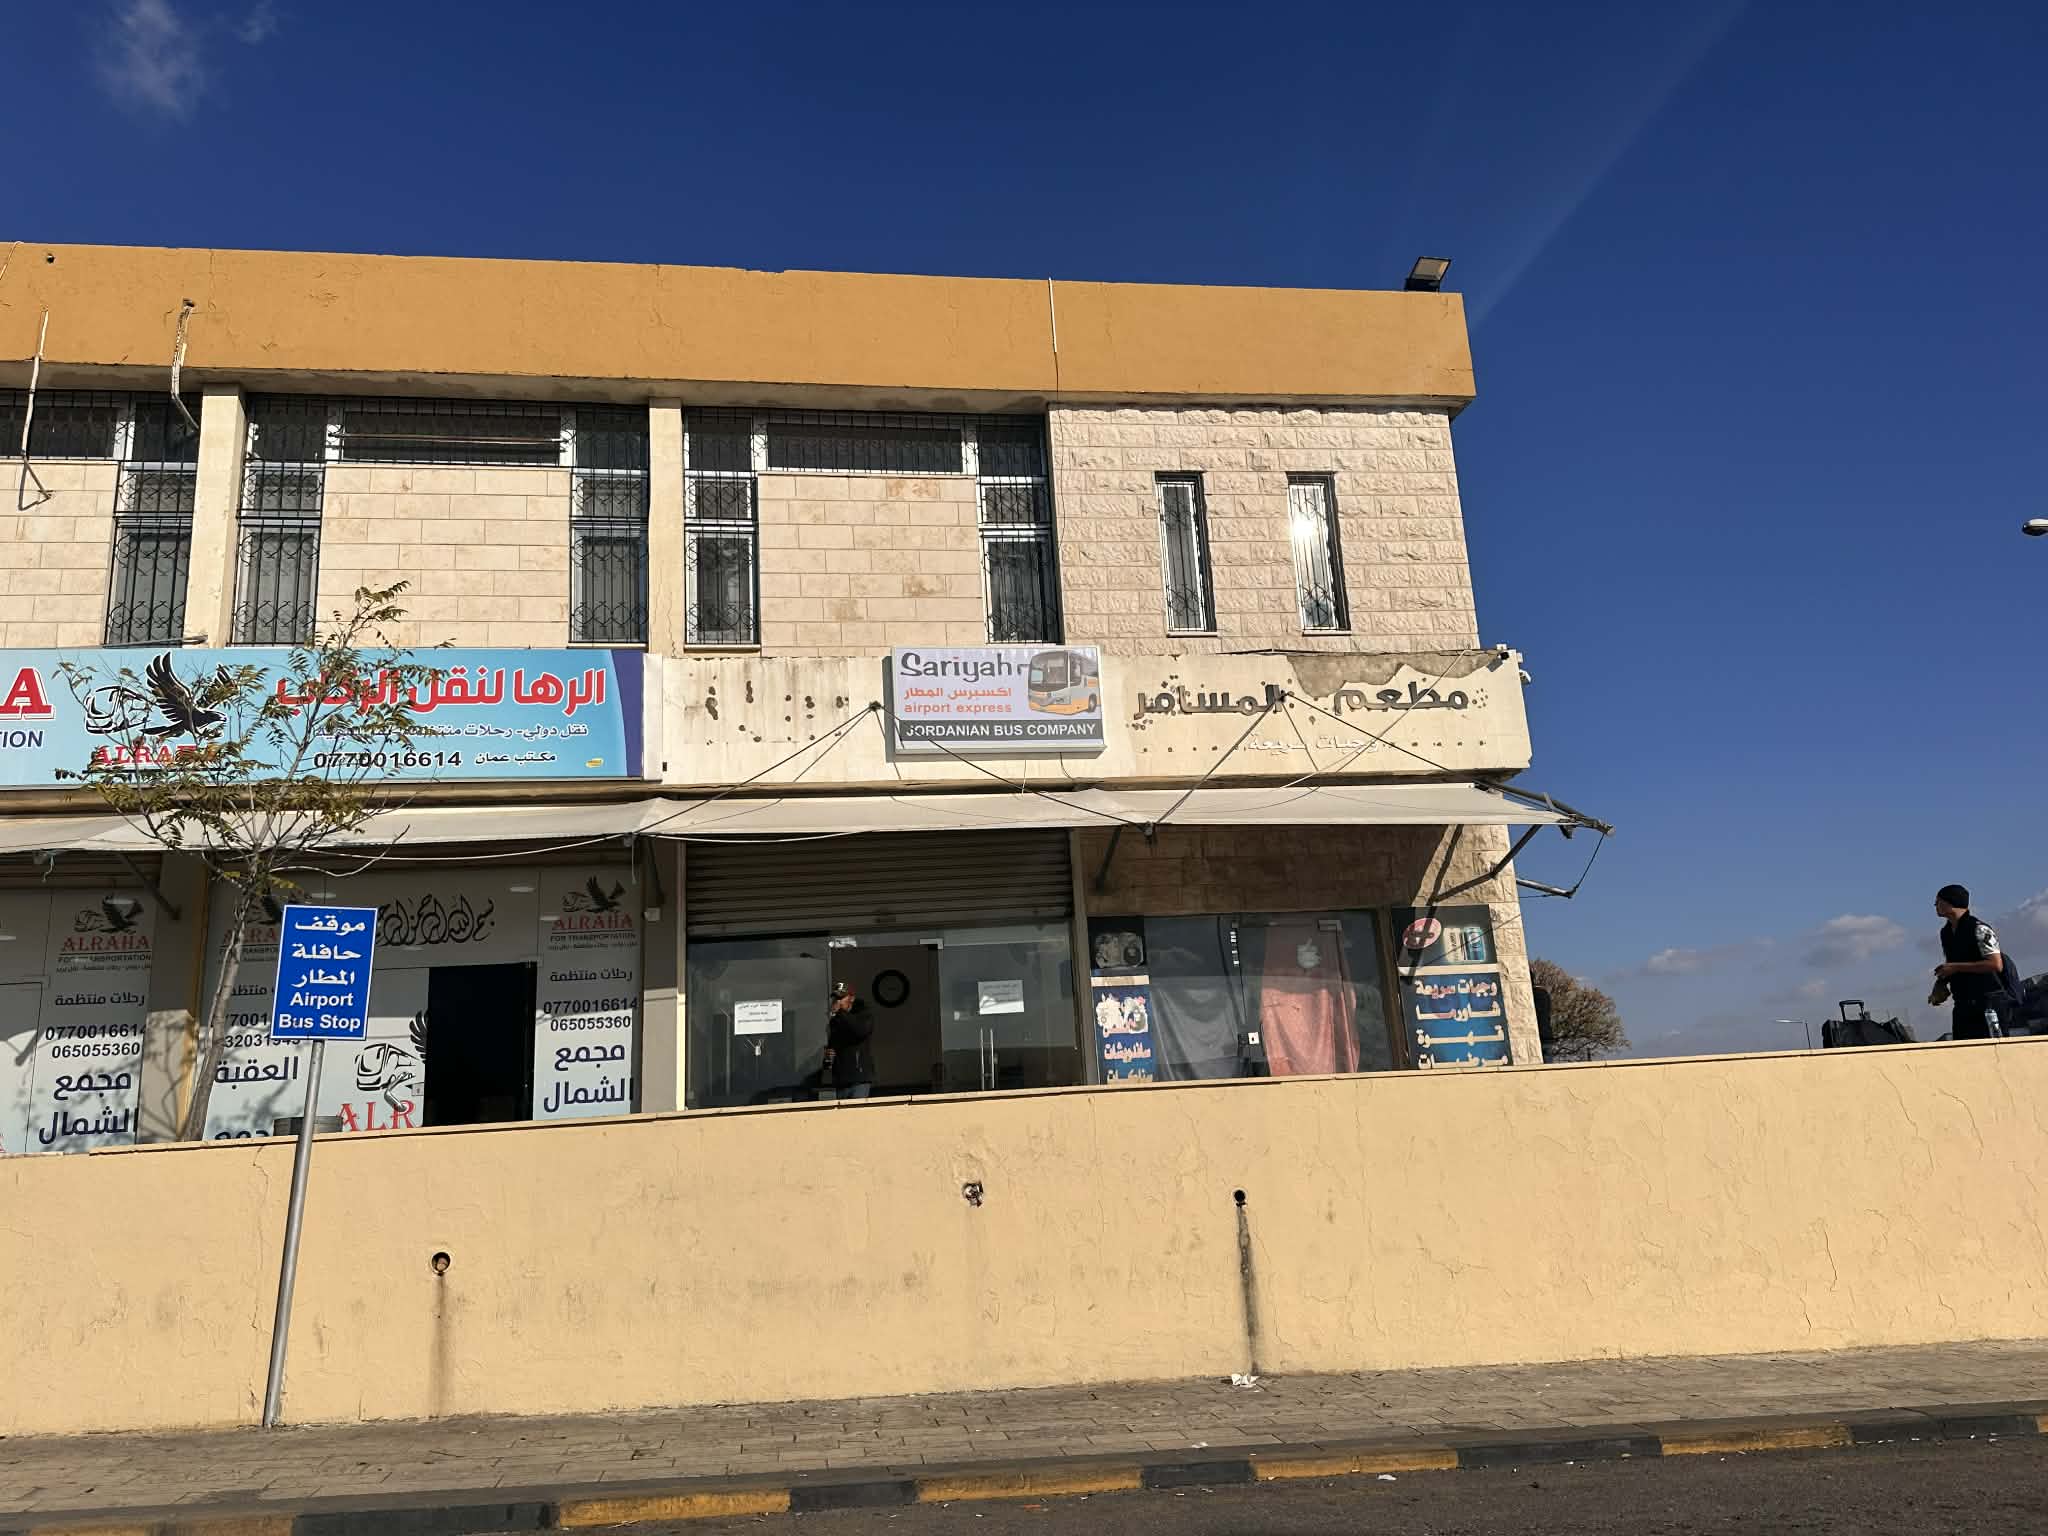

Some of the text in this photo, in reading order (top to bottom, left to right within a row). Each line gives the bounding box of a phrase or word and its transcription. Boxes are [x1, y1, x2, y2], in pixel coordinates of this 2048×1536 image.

[900, 652, 1012, 682] Sariyah
[408, 667, 504, 713] لنقل
[514, 668, 605, 716] الرها
[904, 687, 943, 700] المطار
[1334, 681, 1468, 716] مطعم
[904, 703, 1012, 714] airport express
[0, 730, 44, 748] ION
[464, 724, 512, 737] رحلات
[561, 725, 587, 737] نقل
[906, 723, 1096, 737] JORDANIAN BUS COMPANY
[314, 751, 461, 768] 0770016614
[475, 751, 555, 764] مكتب عمان
[295, 915, 366, 936] موقف
[553, 913, 633, 931] ALRAHA
[61, 935, 151, 952] ALRAHA
[291, 943, 362, 960] حافلة
[291, 968, 355, 988] المطار
[550, 967, 632, 982] رحلات منتظمة
[1414, 978, 1497, 999] وجبات سريعة
[55, 992, 145, 1006] رحلات منتظمة
[289, 991, 354, 1009] Airport
[543, 997, 638, 1014] 0770016614
[279, 1013, 361, 1032] Bus Stop
[550, 1016, 631, 1031] 065055360
[52, 1042, 140, 1058] 065055360
[554, 1044, 625, 1072] مجمع
[215, 1056, 298, 1090] العقبة
[53, 1072, 132, 1101] مجمع
[543, 1075, 634, 1113] الشمال
[39, 1106, 139, 1145] الشمال
